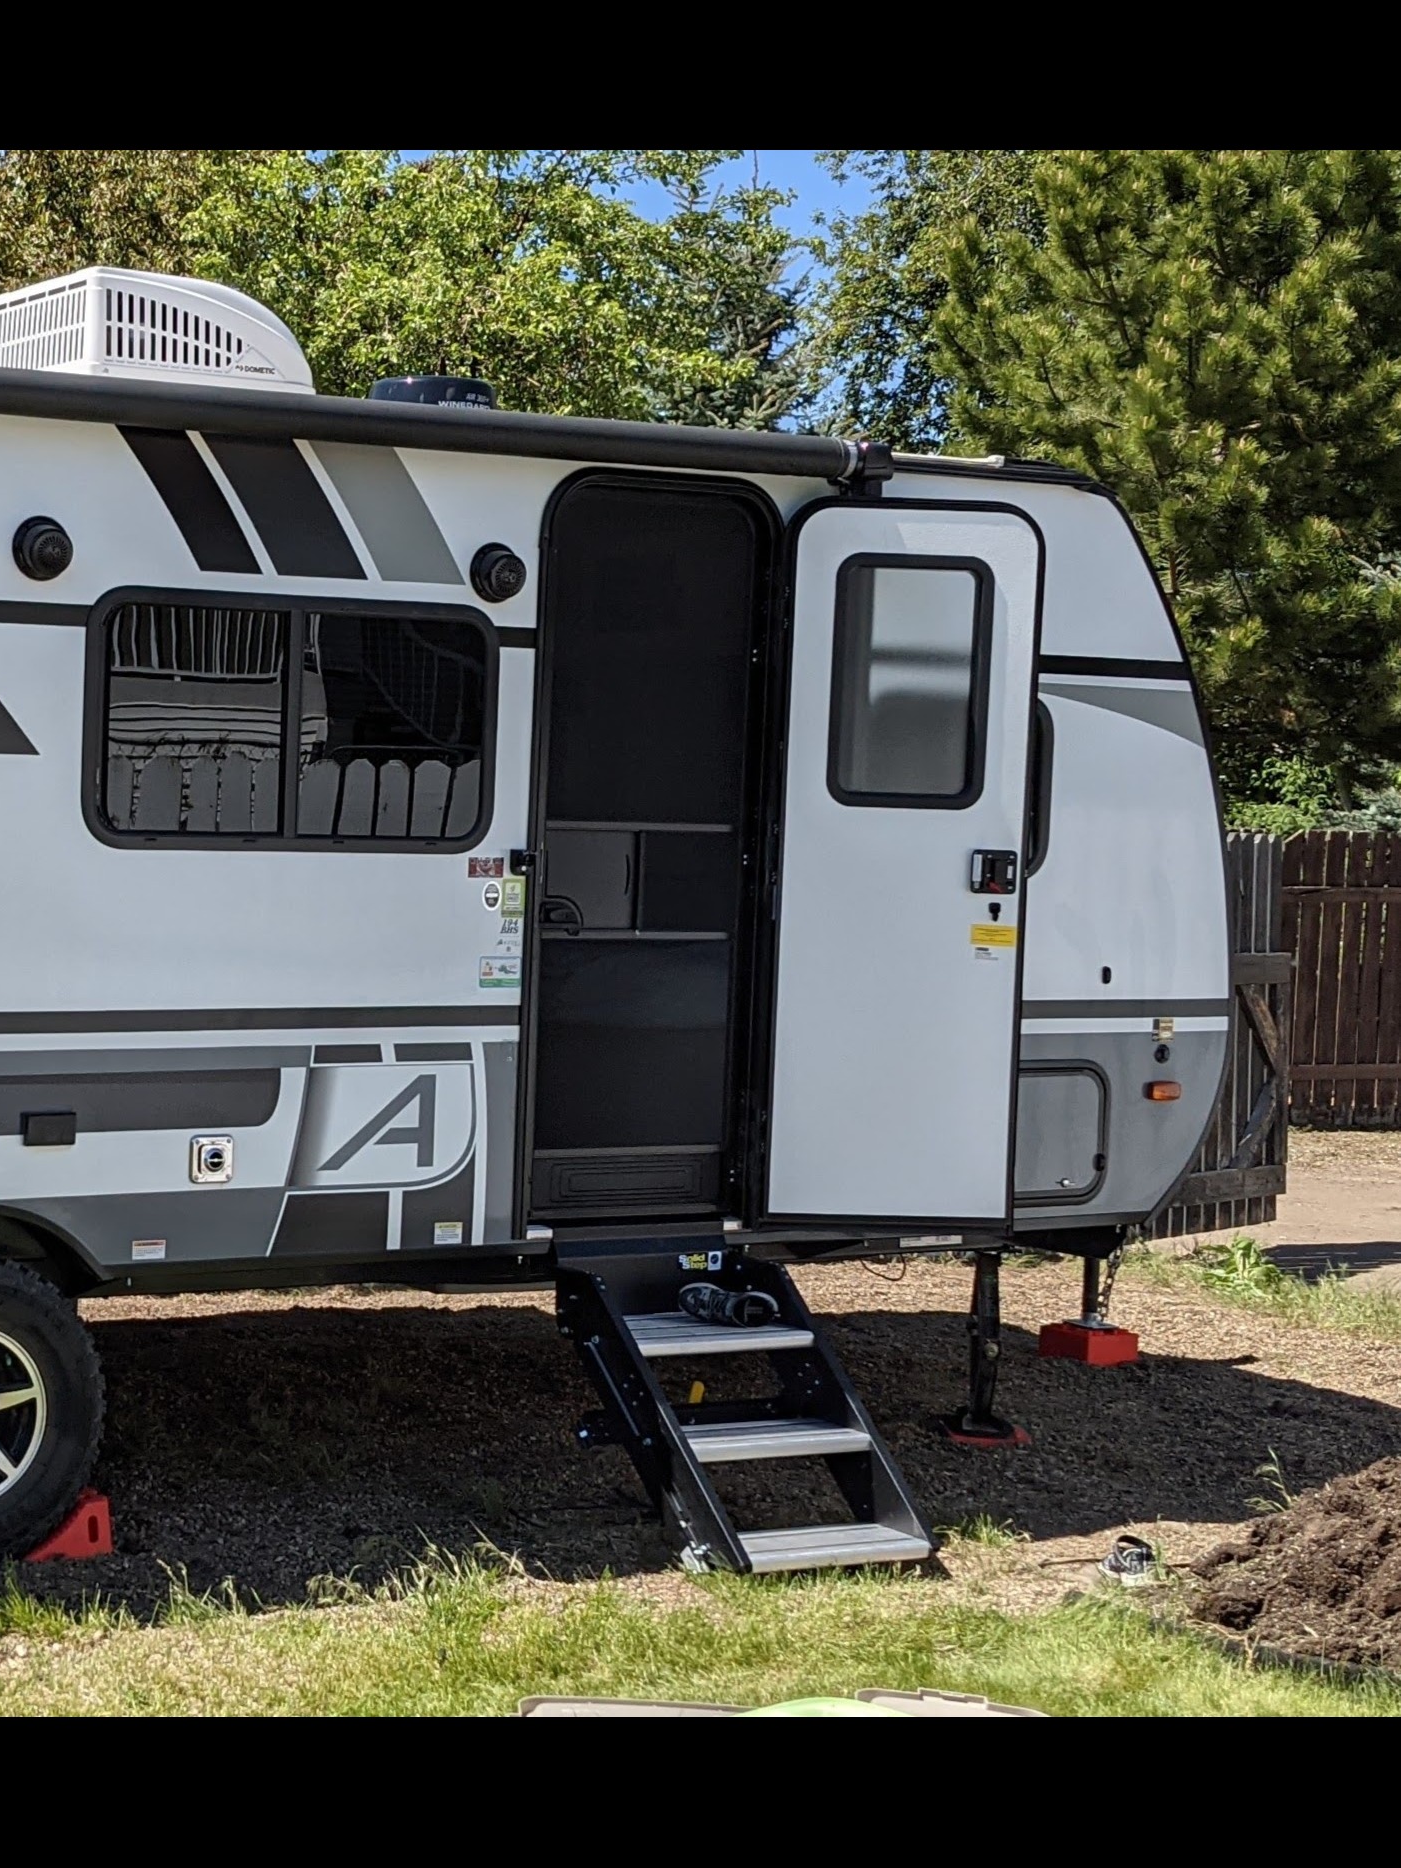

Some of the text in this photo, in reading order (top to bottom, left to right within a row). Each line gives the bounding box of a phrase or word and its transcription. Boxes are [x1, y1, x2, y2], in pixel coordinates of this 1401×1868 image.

[244, 365, 276, 374] DOMETIC
[502, 918, 519, 927] 194
[678, 1253, 706, 1263] Solid
[681, 1261, 708, 1270] Step
